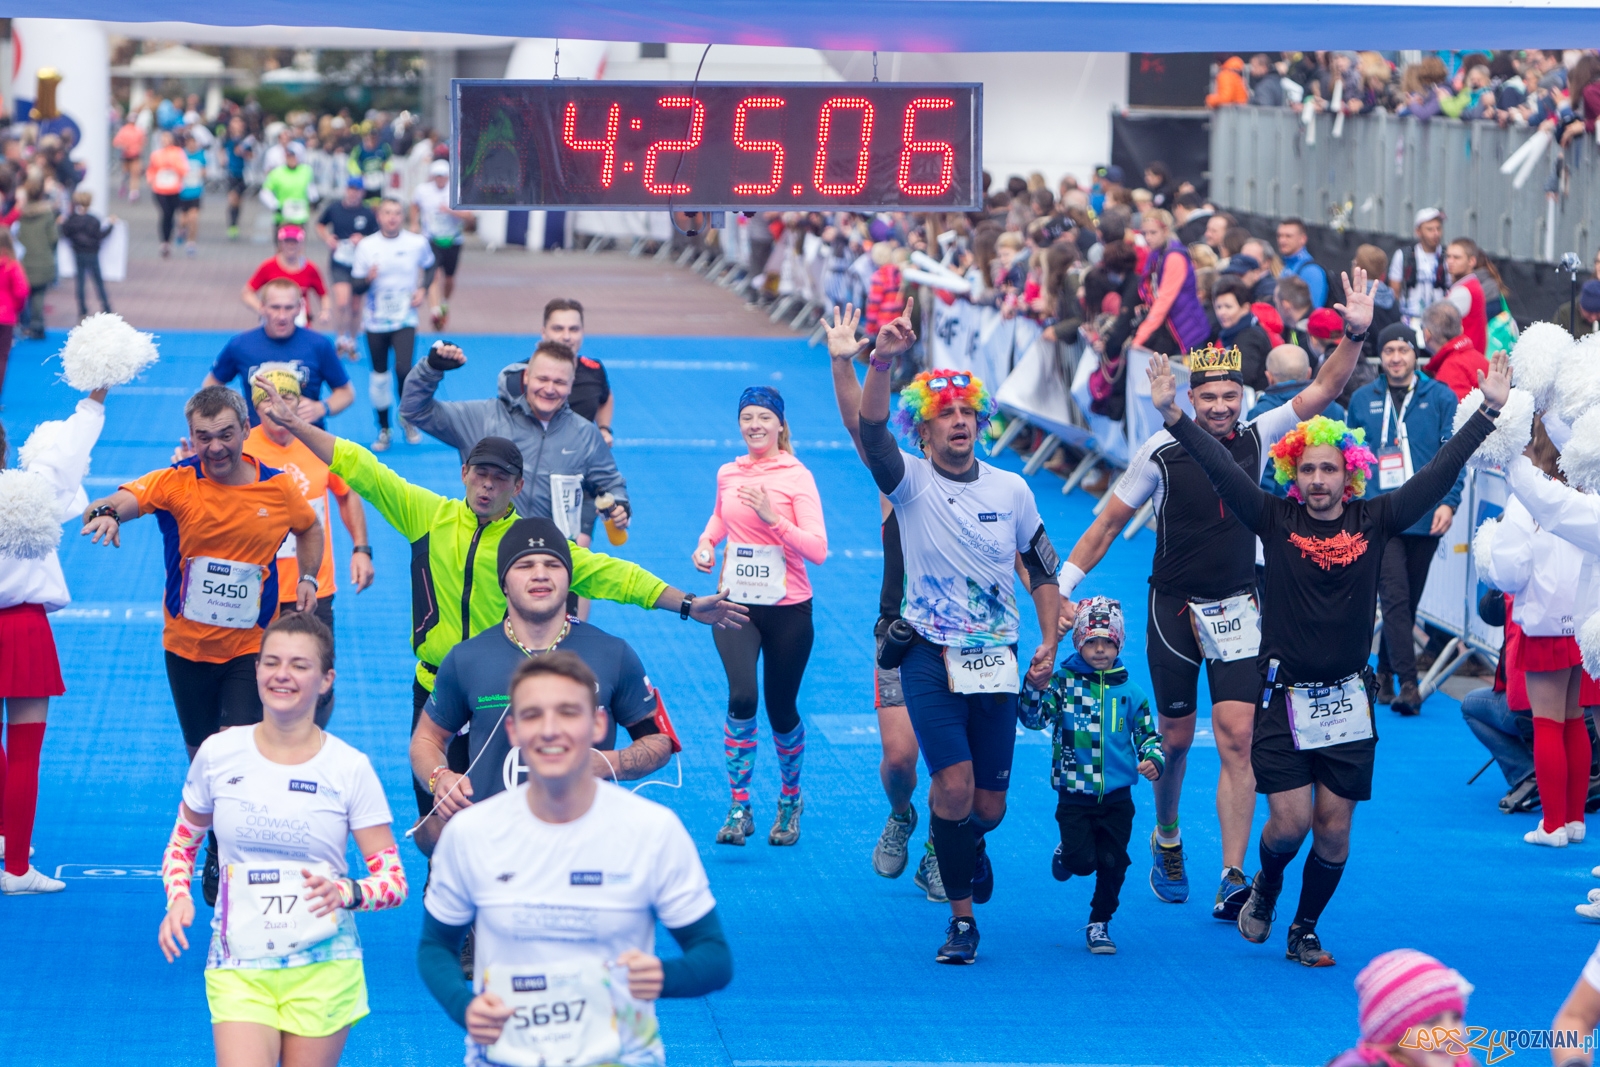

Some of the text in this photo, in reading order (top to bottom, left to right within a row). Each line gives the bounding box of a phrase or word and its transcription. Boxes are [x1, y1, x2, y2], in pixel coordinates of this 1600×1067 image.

[563, 97, 955, 196] 4:25.06
[736, 563, 770, 578] 6013
[202, 579, 248, 599] 5450
[207, 598, 242, 609] Arkadiusz
[962, 654, 1006, 672] 4006
[1309, 698, 1353, 719] 2325
[1319, 716, 1347, 728] Krystian
[239, 800, 269, 815] SIŁA
[245, 814, 311, 831] ODWAGA
[235, 826, 311, 845] SZYBKOŚĆ
[260, 895, 298, 915] 717
[264, 920, 288, 930] Zuza
[513, 998, 586, 1030] 5697
